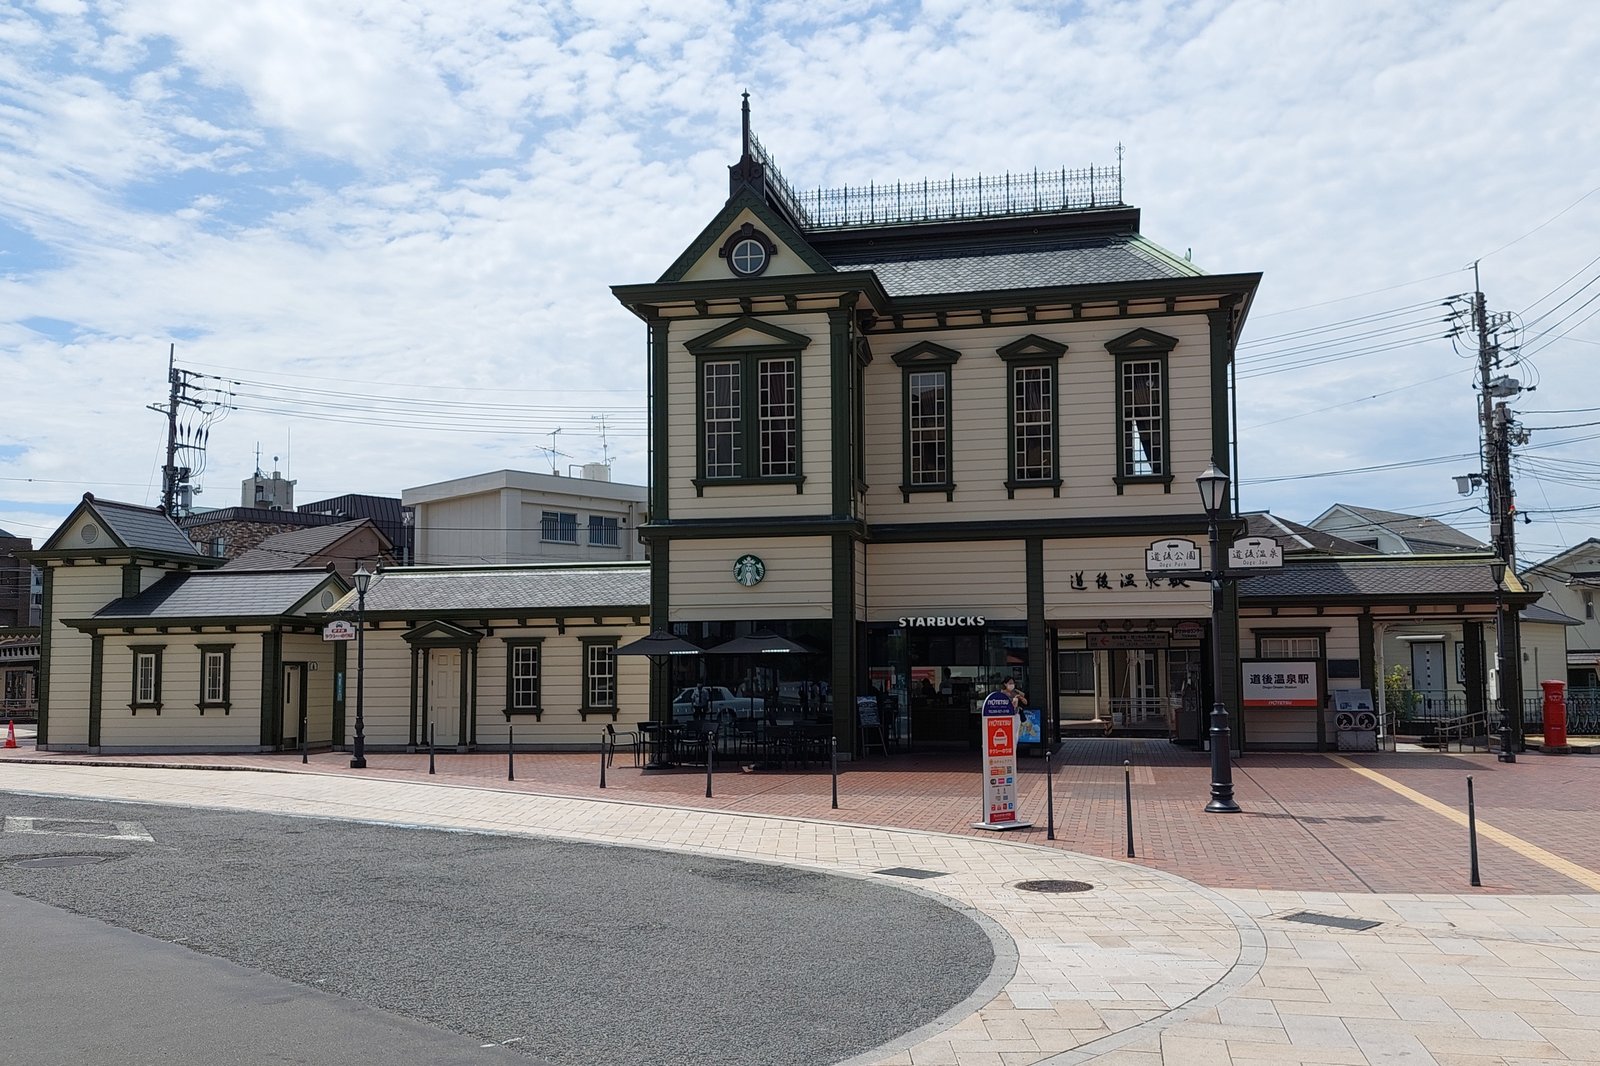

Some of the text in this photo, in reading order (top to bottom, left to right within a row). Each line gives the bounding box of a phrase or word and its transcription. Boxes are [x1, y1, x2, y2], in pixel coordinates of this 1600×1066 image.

[1151, 550, 1196, 561] 道後公園
[1232, 548, 1279, 559] 道後温泉
[898, 615, 985, 627] STARBUCKS
[1249, 673, 1309, 684] 道後温泉駅
